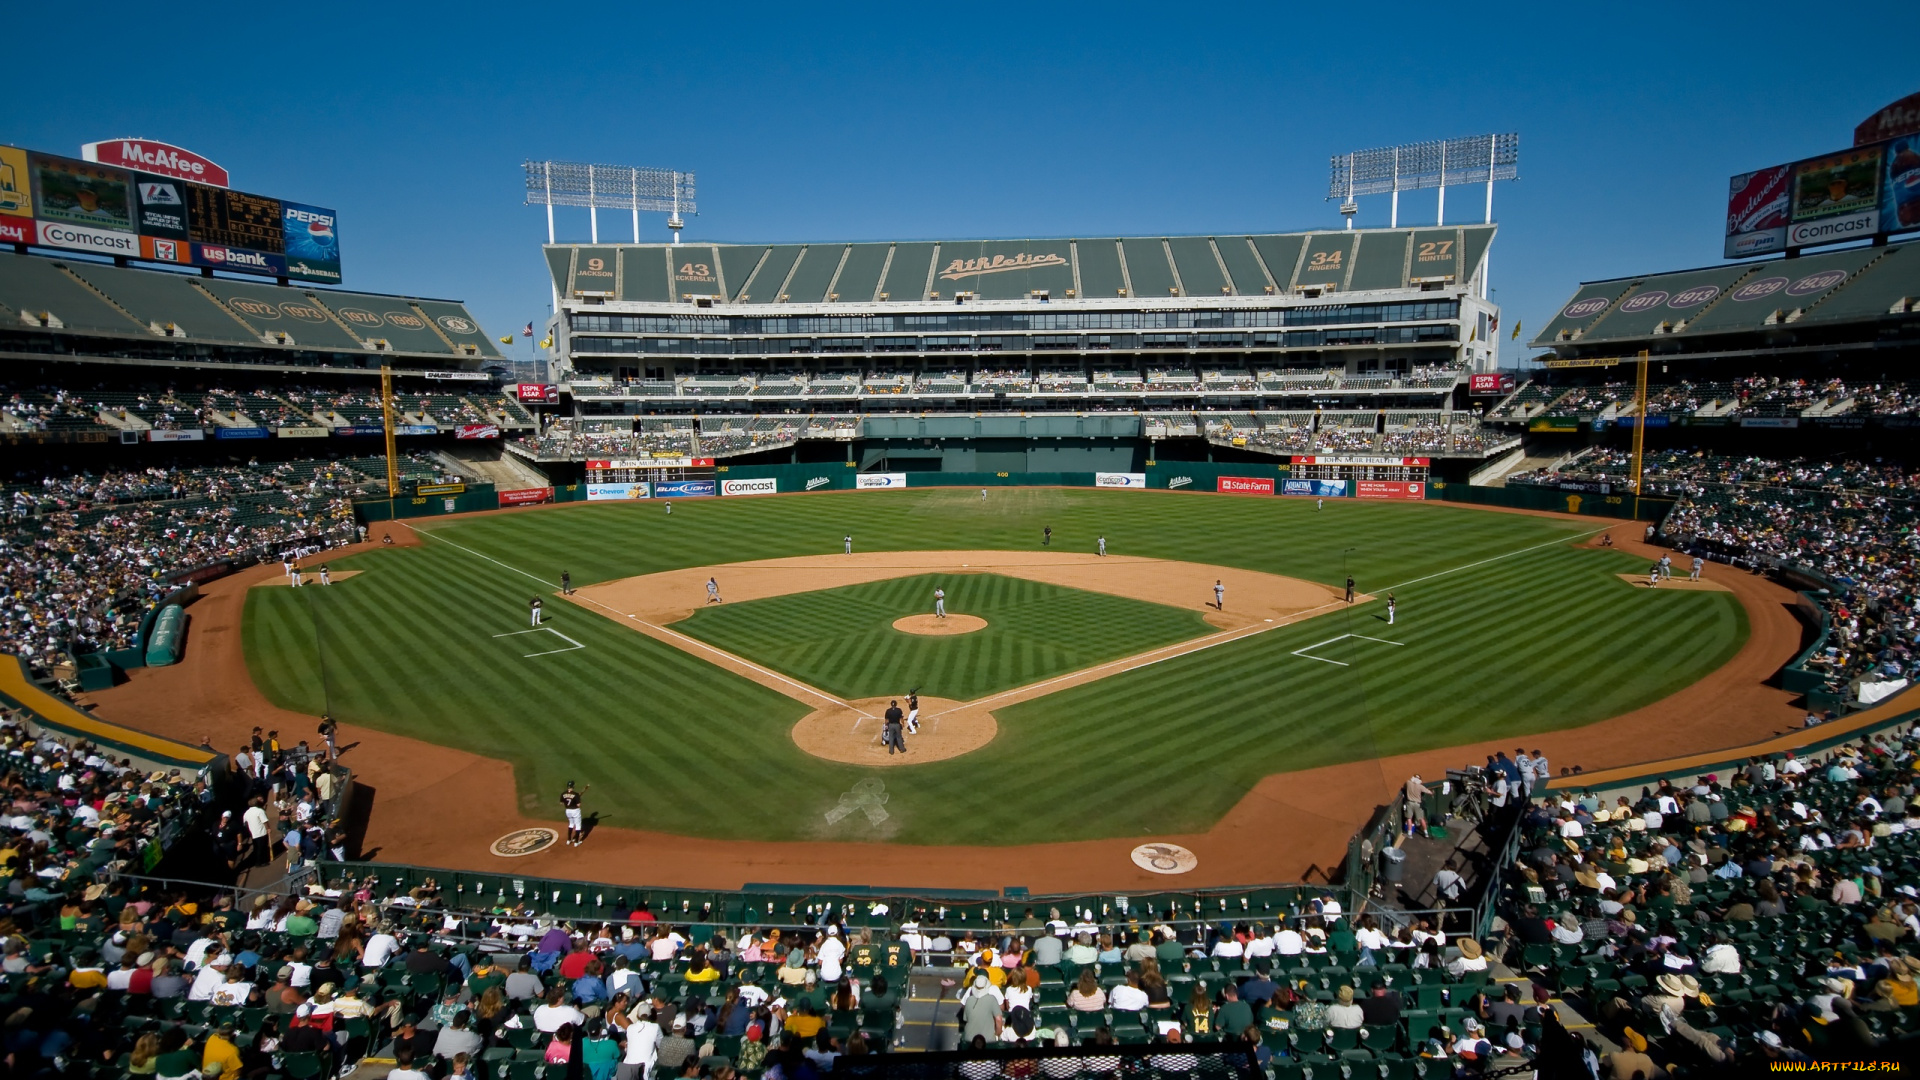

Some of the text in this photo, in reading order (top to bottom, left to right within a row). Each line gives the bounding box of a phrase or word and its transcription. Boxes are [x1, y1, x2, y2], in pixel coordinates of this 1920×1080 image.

[122, 142, 204, 174] McAfee
[227, 192, 279, 207] 56 Pennington
[1727, 164, 1791, 235] Budweiser
[1822, 198, 1874, 212] PENNINGTON
[74, 213, 130, 226] PENNINGTON
[286, 208, 334, 226] PEPSI
[1795, 217, 1872, 241] comcast
[47, 227, 132, 250] comcast
[1419, 241, 1454, 256] 27
[588, 258, 604, 270] 9
[1310, 250, 1342, 266] 34
[680, 263, 709, 276] 43
[938, 252, 1066, 278] Athletics
[307, 268, 340, 278] BASEBALL
[1792, 274, 1841, 290] 1930
[1738, 281, 1784, 297] 1929
[1626, 295, 1661, 308] 1911
[1673, 290, 1714, 305] 1913
[234, 302, 276, 314] 1972
[284, 306, 322, 318] 1973
[1568, 301, 1604, 314] 1910
[344, 312, 378, 323] 1974
[388, 315, 421, 326] 1989
[458, 426, 496, 438] Budweiser
[726, 481, 774, 493] comcast
[1232, 481, 1270, 490] State Farm
[1284, 481, 1312, 491] AQUAFINA
[1560, 482, 1599, 492] metroPCS
[1606, 496, 1622, 504] 330
[889, 955, 897, 966] 6
[1194, 1018, 1209, 1033] 14
